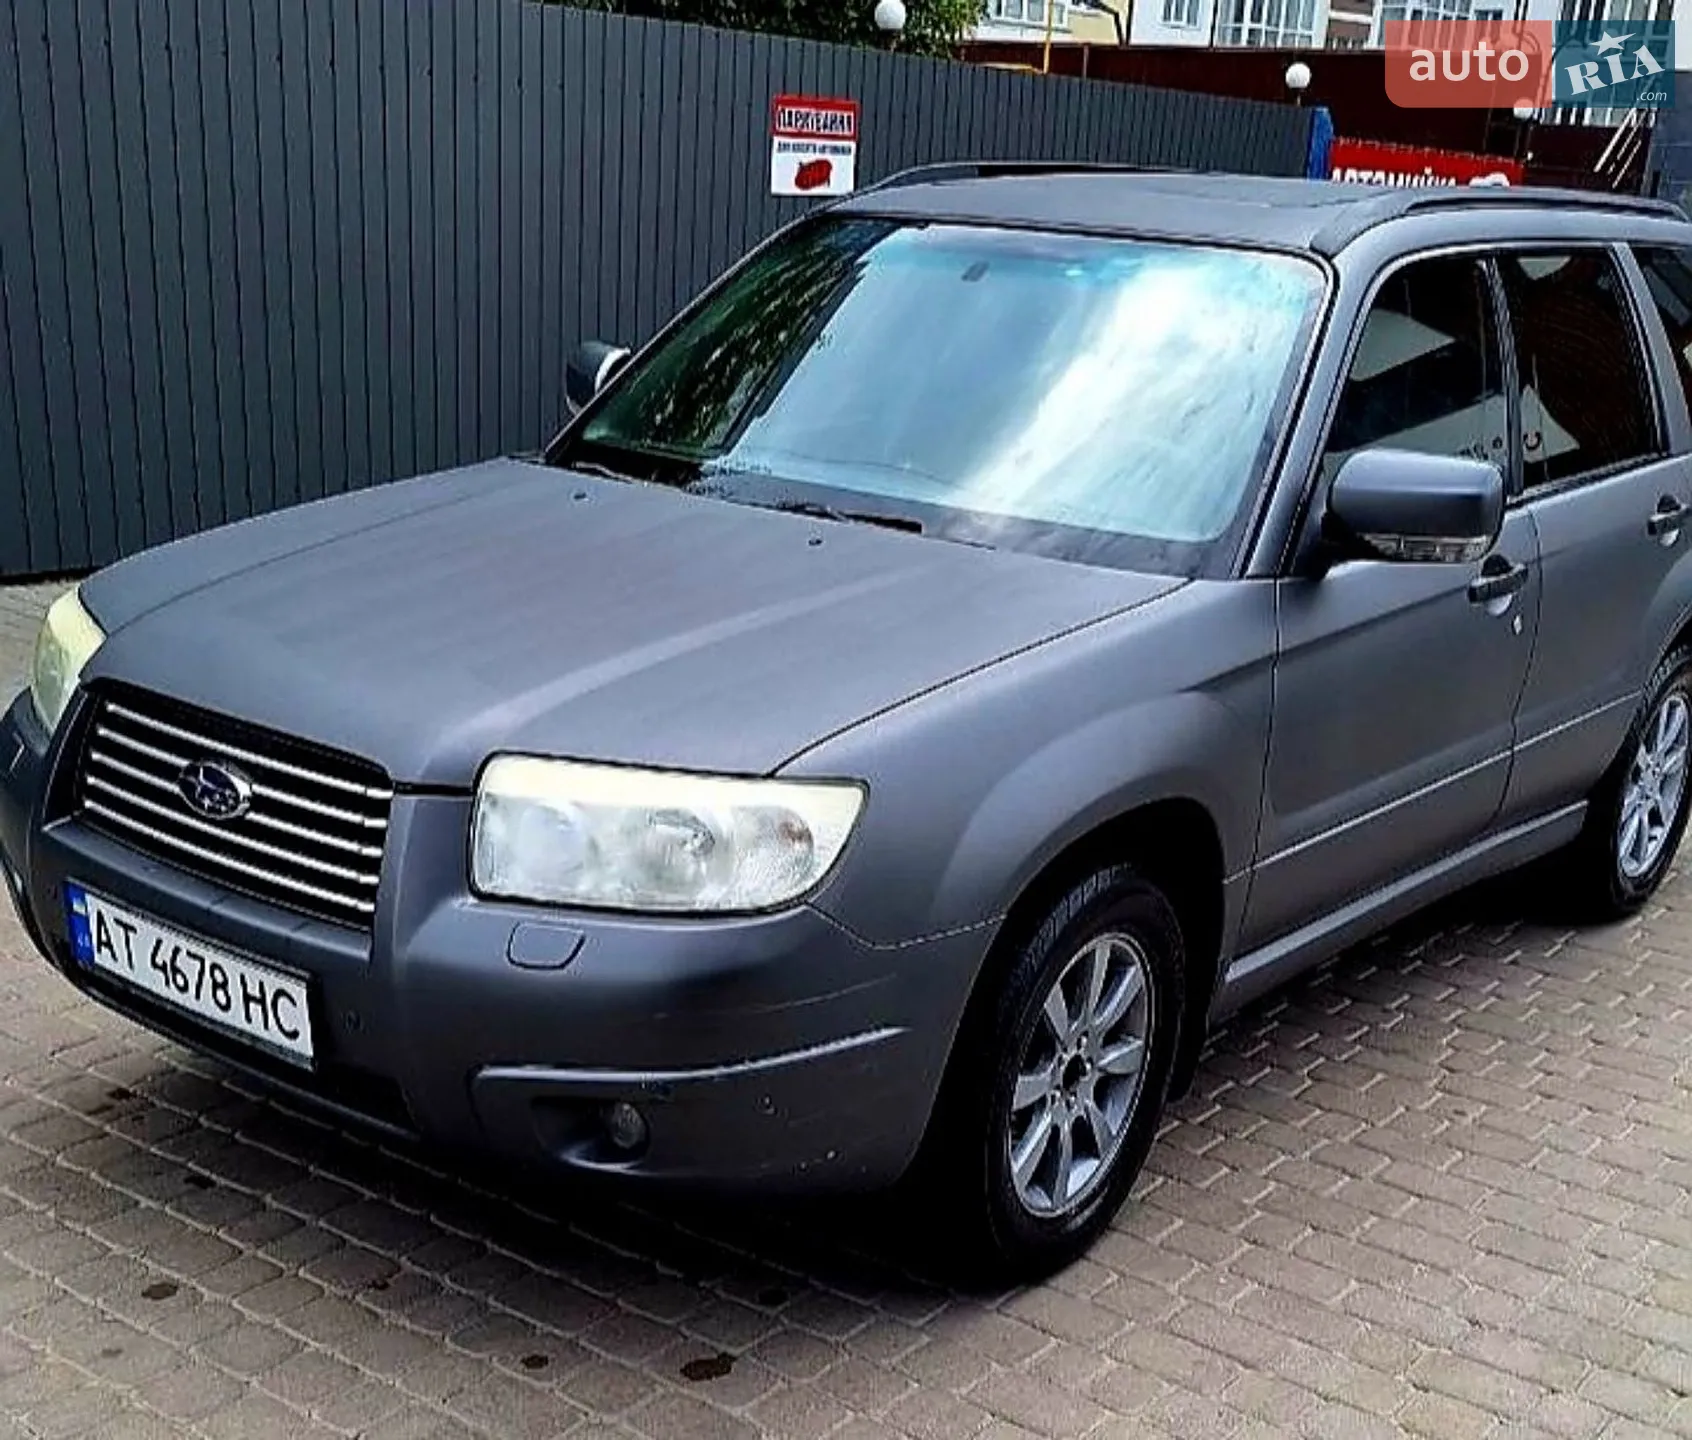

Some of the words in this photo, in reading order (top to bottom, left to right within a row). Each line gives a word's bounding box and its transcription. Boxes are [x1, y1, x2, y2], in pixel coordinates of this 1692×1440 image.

[96, 908, 138, 972] AT
[150, 937, 232, 1013] 4678
[239, 973, 300, 1041] HC
